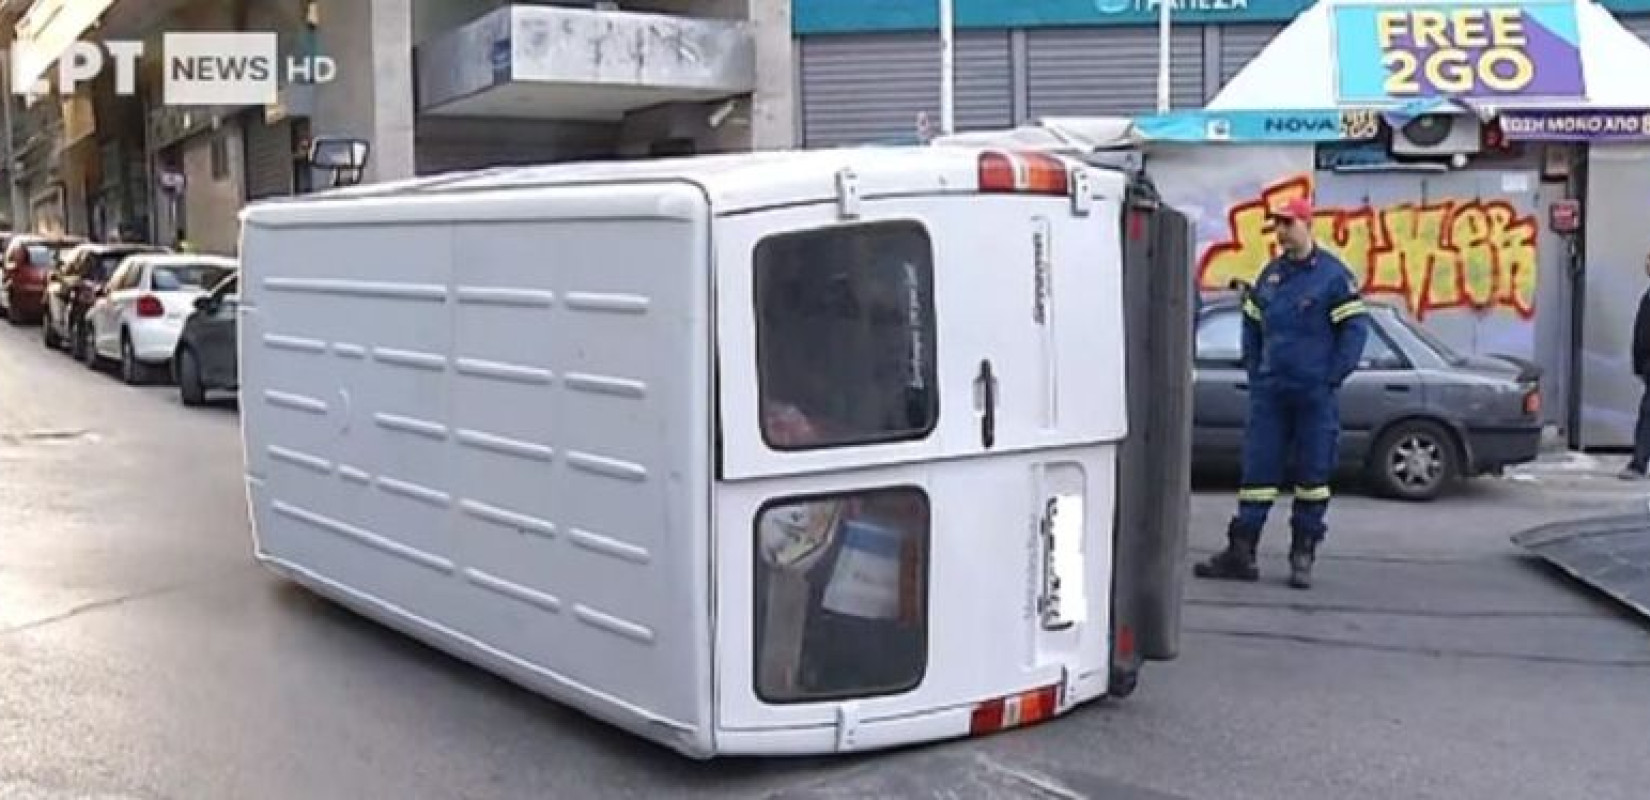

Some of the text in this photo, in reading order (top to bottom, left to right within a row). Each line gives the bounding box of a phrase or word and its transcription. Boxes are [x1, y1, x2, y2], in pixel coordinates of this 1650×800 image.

[1378, 9, 1527, 48] FREE
[1383, 48, 1535, 94] 2GO
[1264, 116, 1335, 133] NOVA
